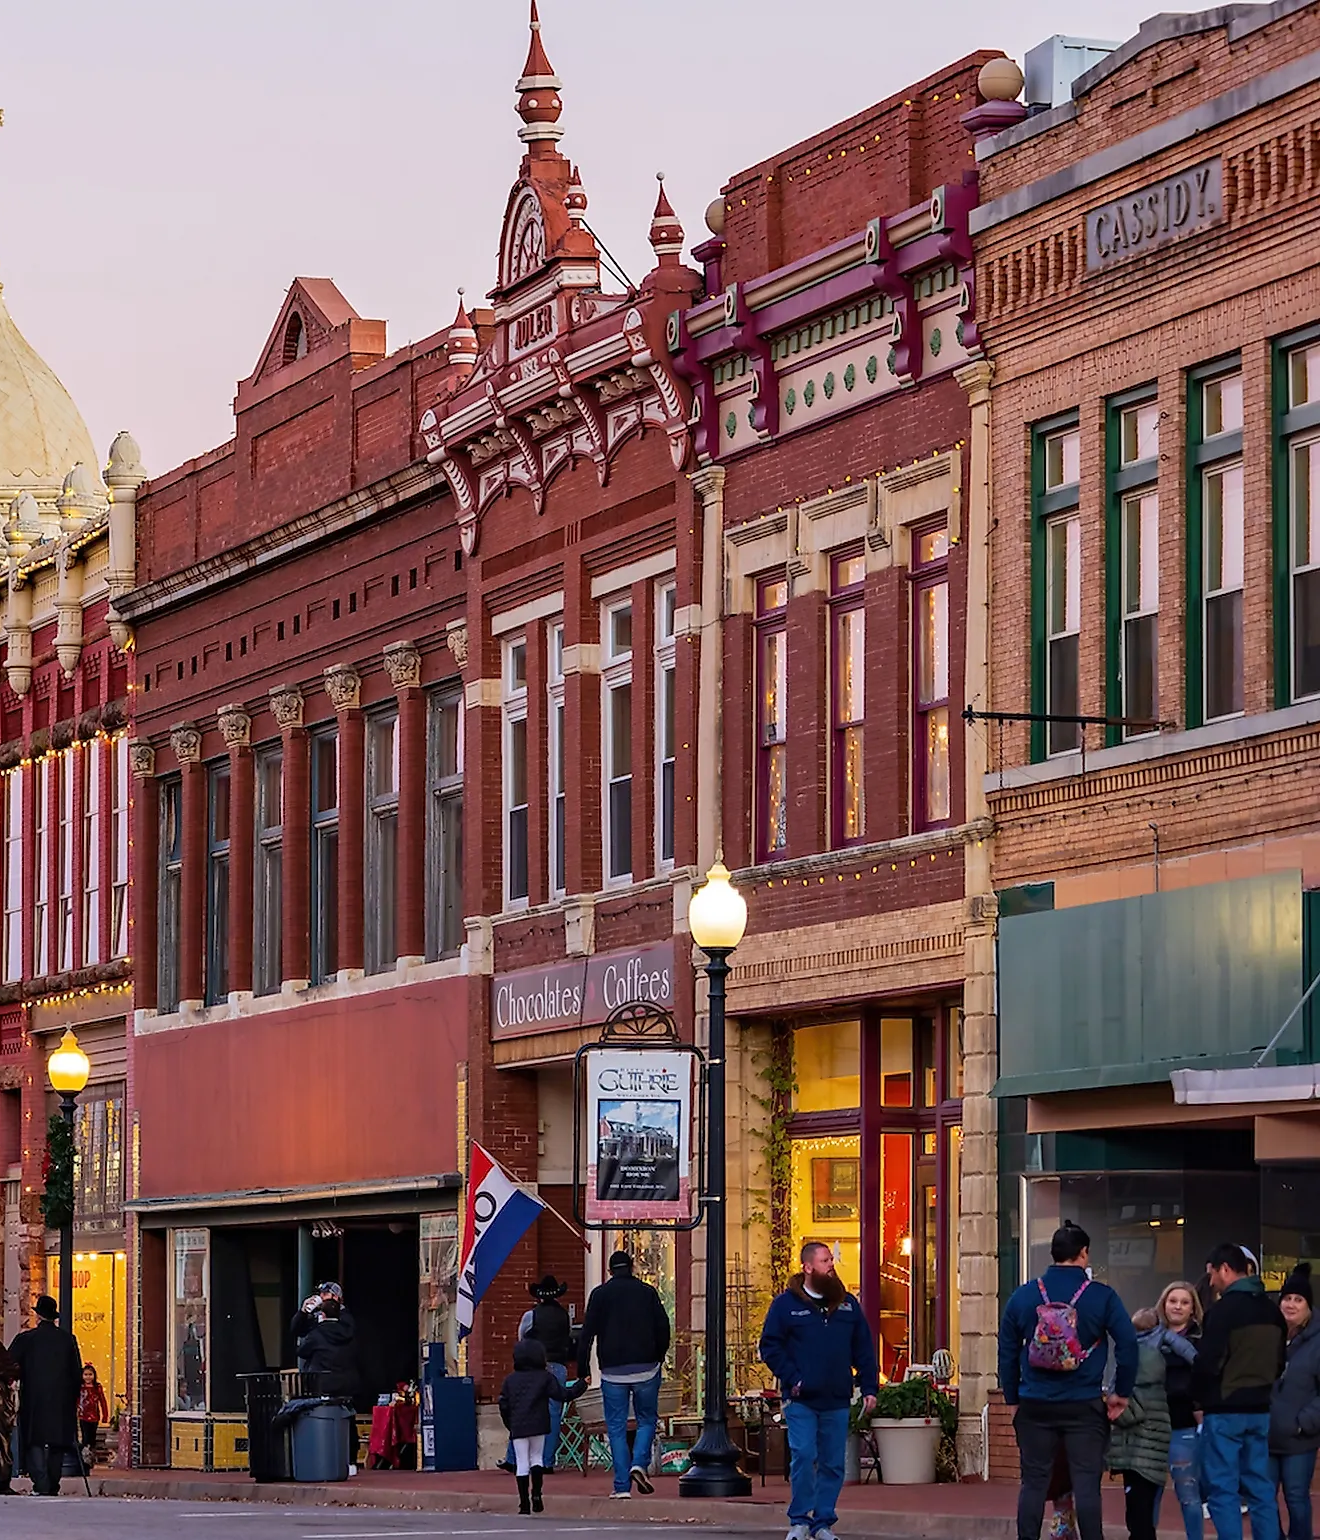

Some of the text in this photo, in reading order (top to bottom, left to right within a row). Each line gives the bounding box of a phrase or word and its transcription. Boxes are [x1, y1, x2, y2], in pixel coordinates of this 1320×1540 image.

[514, 304, 552, 351] ADLER
[497, 976, 580, 1028] Chocolates
[603, 957, 670, 1009] Coffees
[597, 1068, 680, 1094] GUTHRIE
